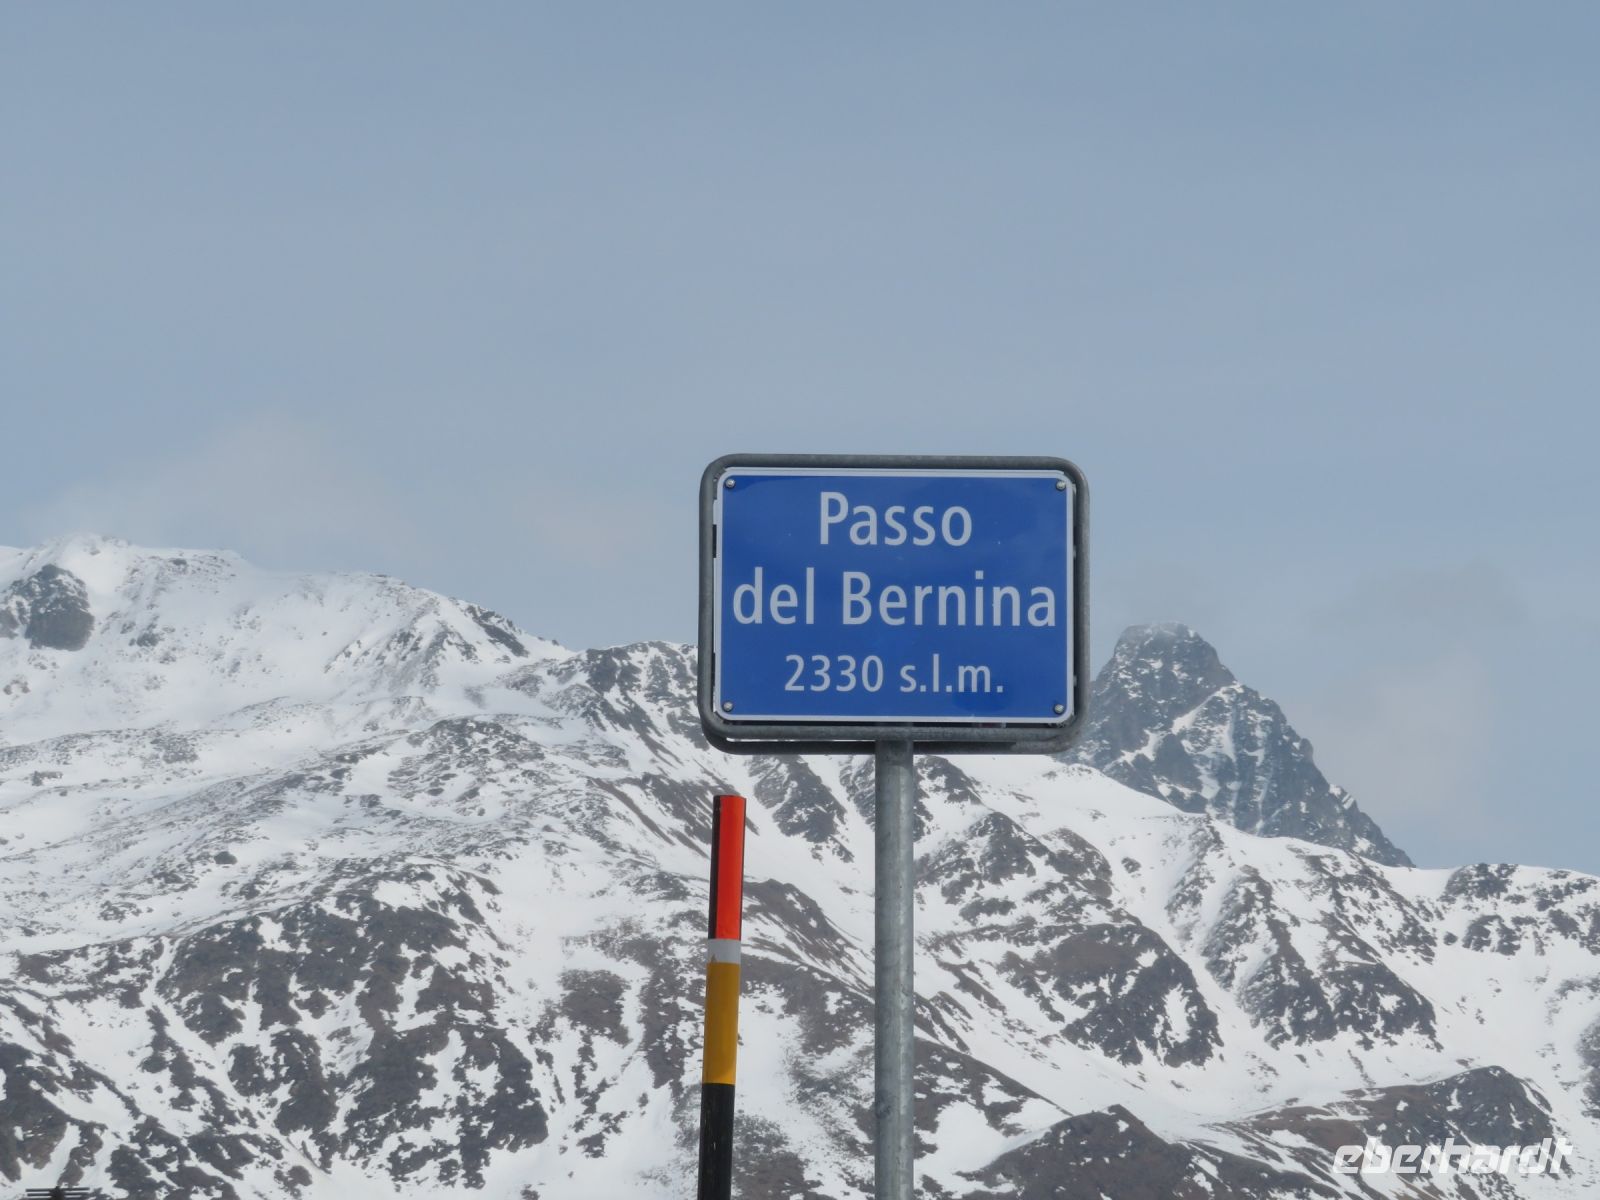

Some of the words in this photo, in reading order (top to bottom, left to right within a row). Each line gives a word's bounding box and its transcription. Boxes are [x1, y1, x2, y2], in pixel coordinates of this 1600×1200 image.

[819, 491, 972, 546] Passo
[733, 567, 814, 625] del
[843, 570, 1055, 627] Bernina
[785, 654, 884, 692] 2330
[900, 653, 1004, 693] s.l.m.
